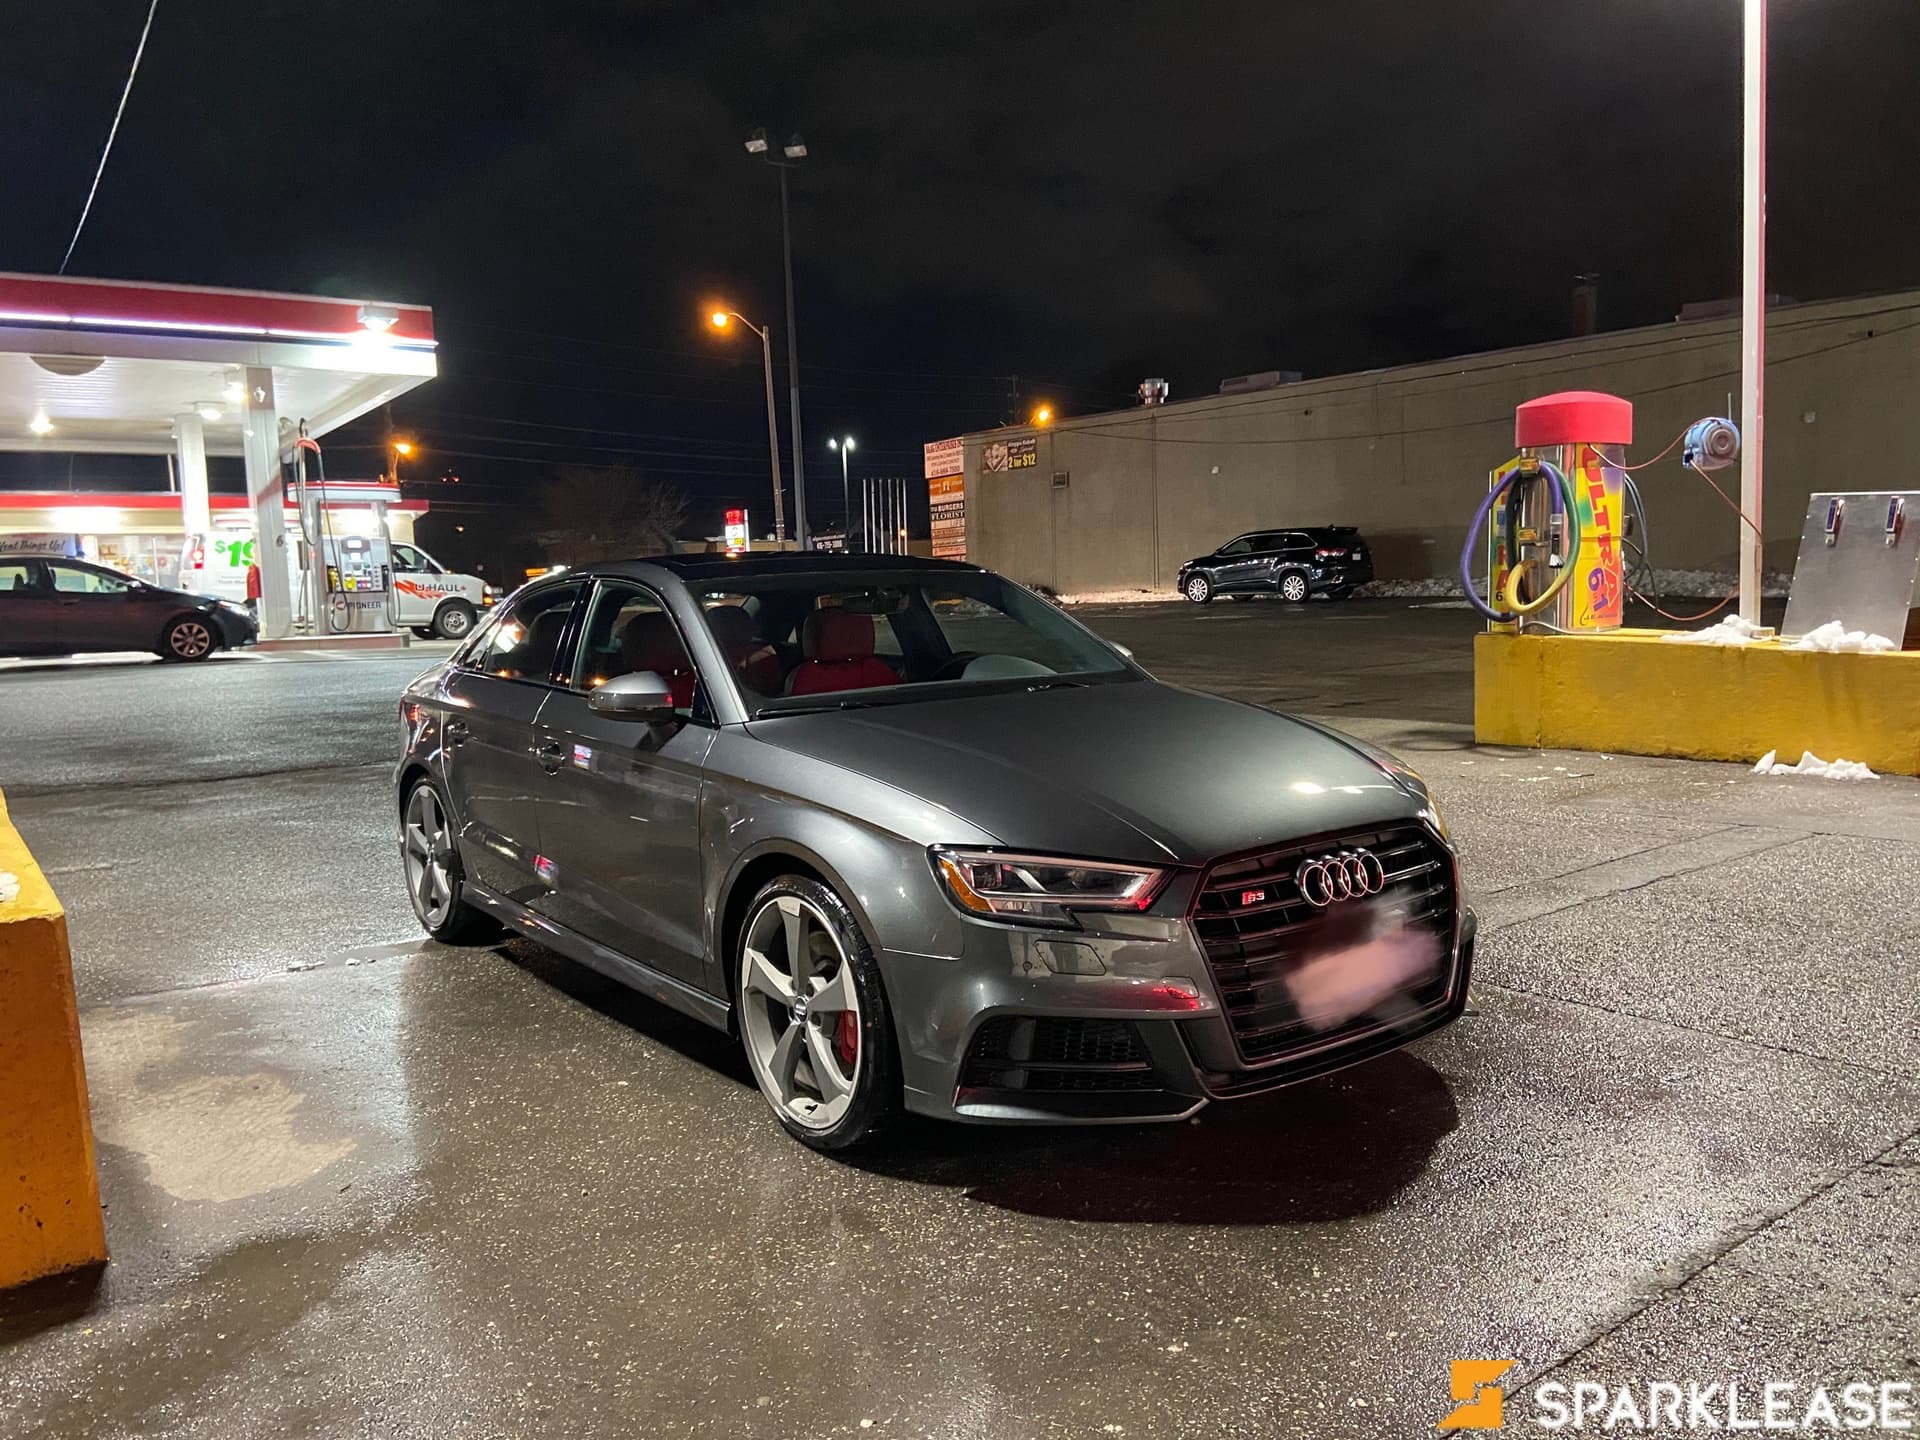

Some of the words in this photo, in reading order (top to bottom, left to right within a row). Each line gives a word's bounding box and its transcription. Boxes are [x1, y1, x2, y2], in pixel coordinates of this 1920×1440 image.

[1008, 456, 1014, 468] 2
[1023, 453, 1036, 467] $12
[931, 510, 965, 521] FLORIST
[1582, 447, 1620, 608] ULTRA
[348, 601, 381, 609] PIONEER
